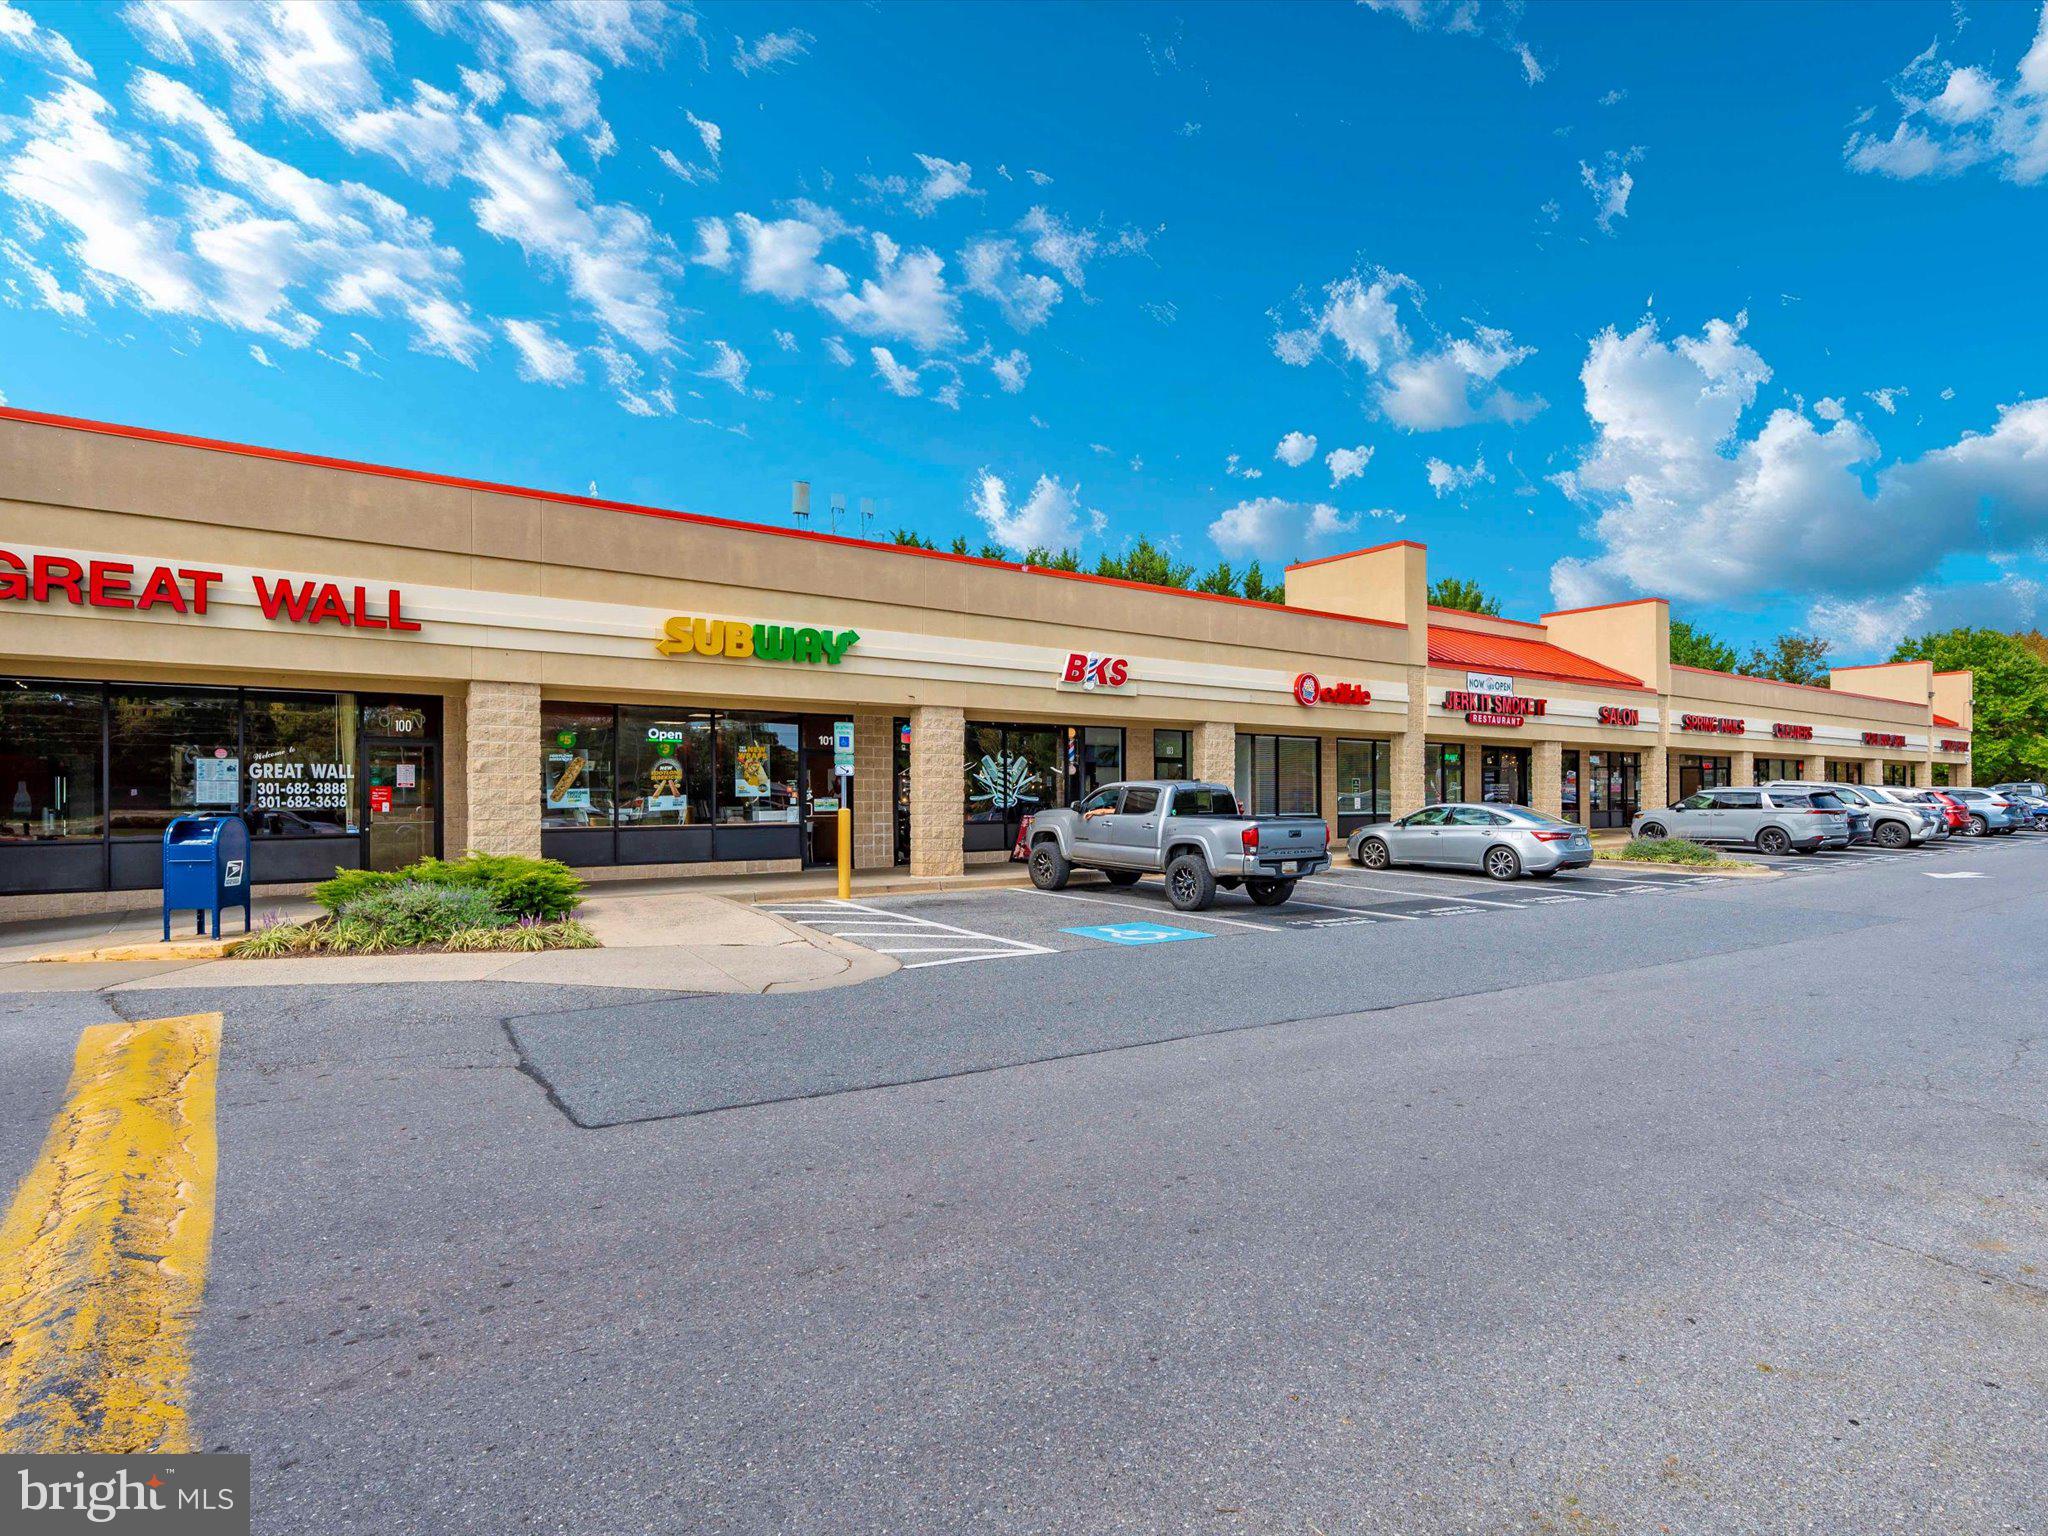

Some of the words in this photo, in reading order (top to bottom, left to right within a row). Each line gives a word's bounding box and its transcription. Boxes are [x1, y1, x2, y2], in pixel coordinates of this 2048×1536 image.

[252, 575, 422, 631] WALL
[656, 616, 861, 665] SUBWAY
[1064, 653, 1128, 687] BKS
[1469, 679, 1485, 689] NOW
[1494, 681, 1511, 692] OPEN
[1443, 691, 1477, 711] JERK
[1480, 694, 1493, 712] IT
[1493, 696, 1534, 715] SMOKE
[1472, 715, 1521, 726] RESTAURANT
[1600, 706, 1639, 726] SALON
[395, 719, 412, 732] 100
[1683, 714, 1719, 734] SPRING
[1720, 717, 1745, 735] NAILS
[648, 728, 683, 742] Open
[819, 735, 834, 746] 101
[253, 750, 286, 761] Welcome
[249, 762, 304, 779] GREAT
[311, 763, 355, 779] WALL
[257, 782, 347, 795] 301-682-3888
[258, 795, 347, 808] 301-682-3636
